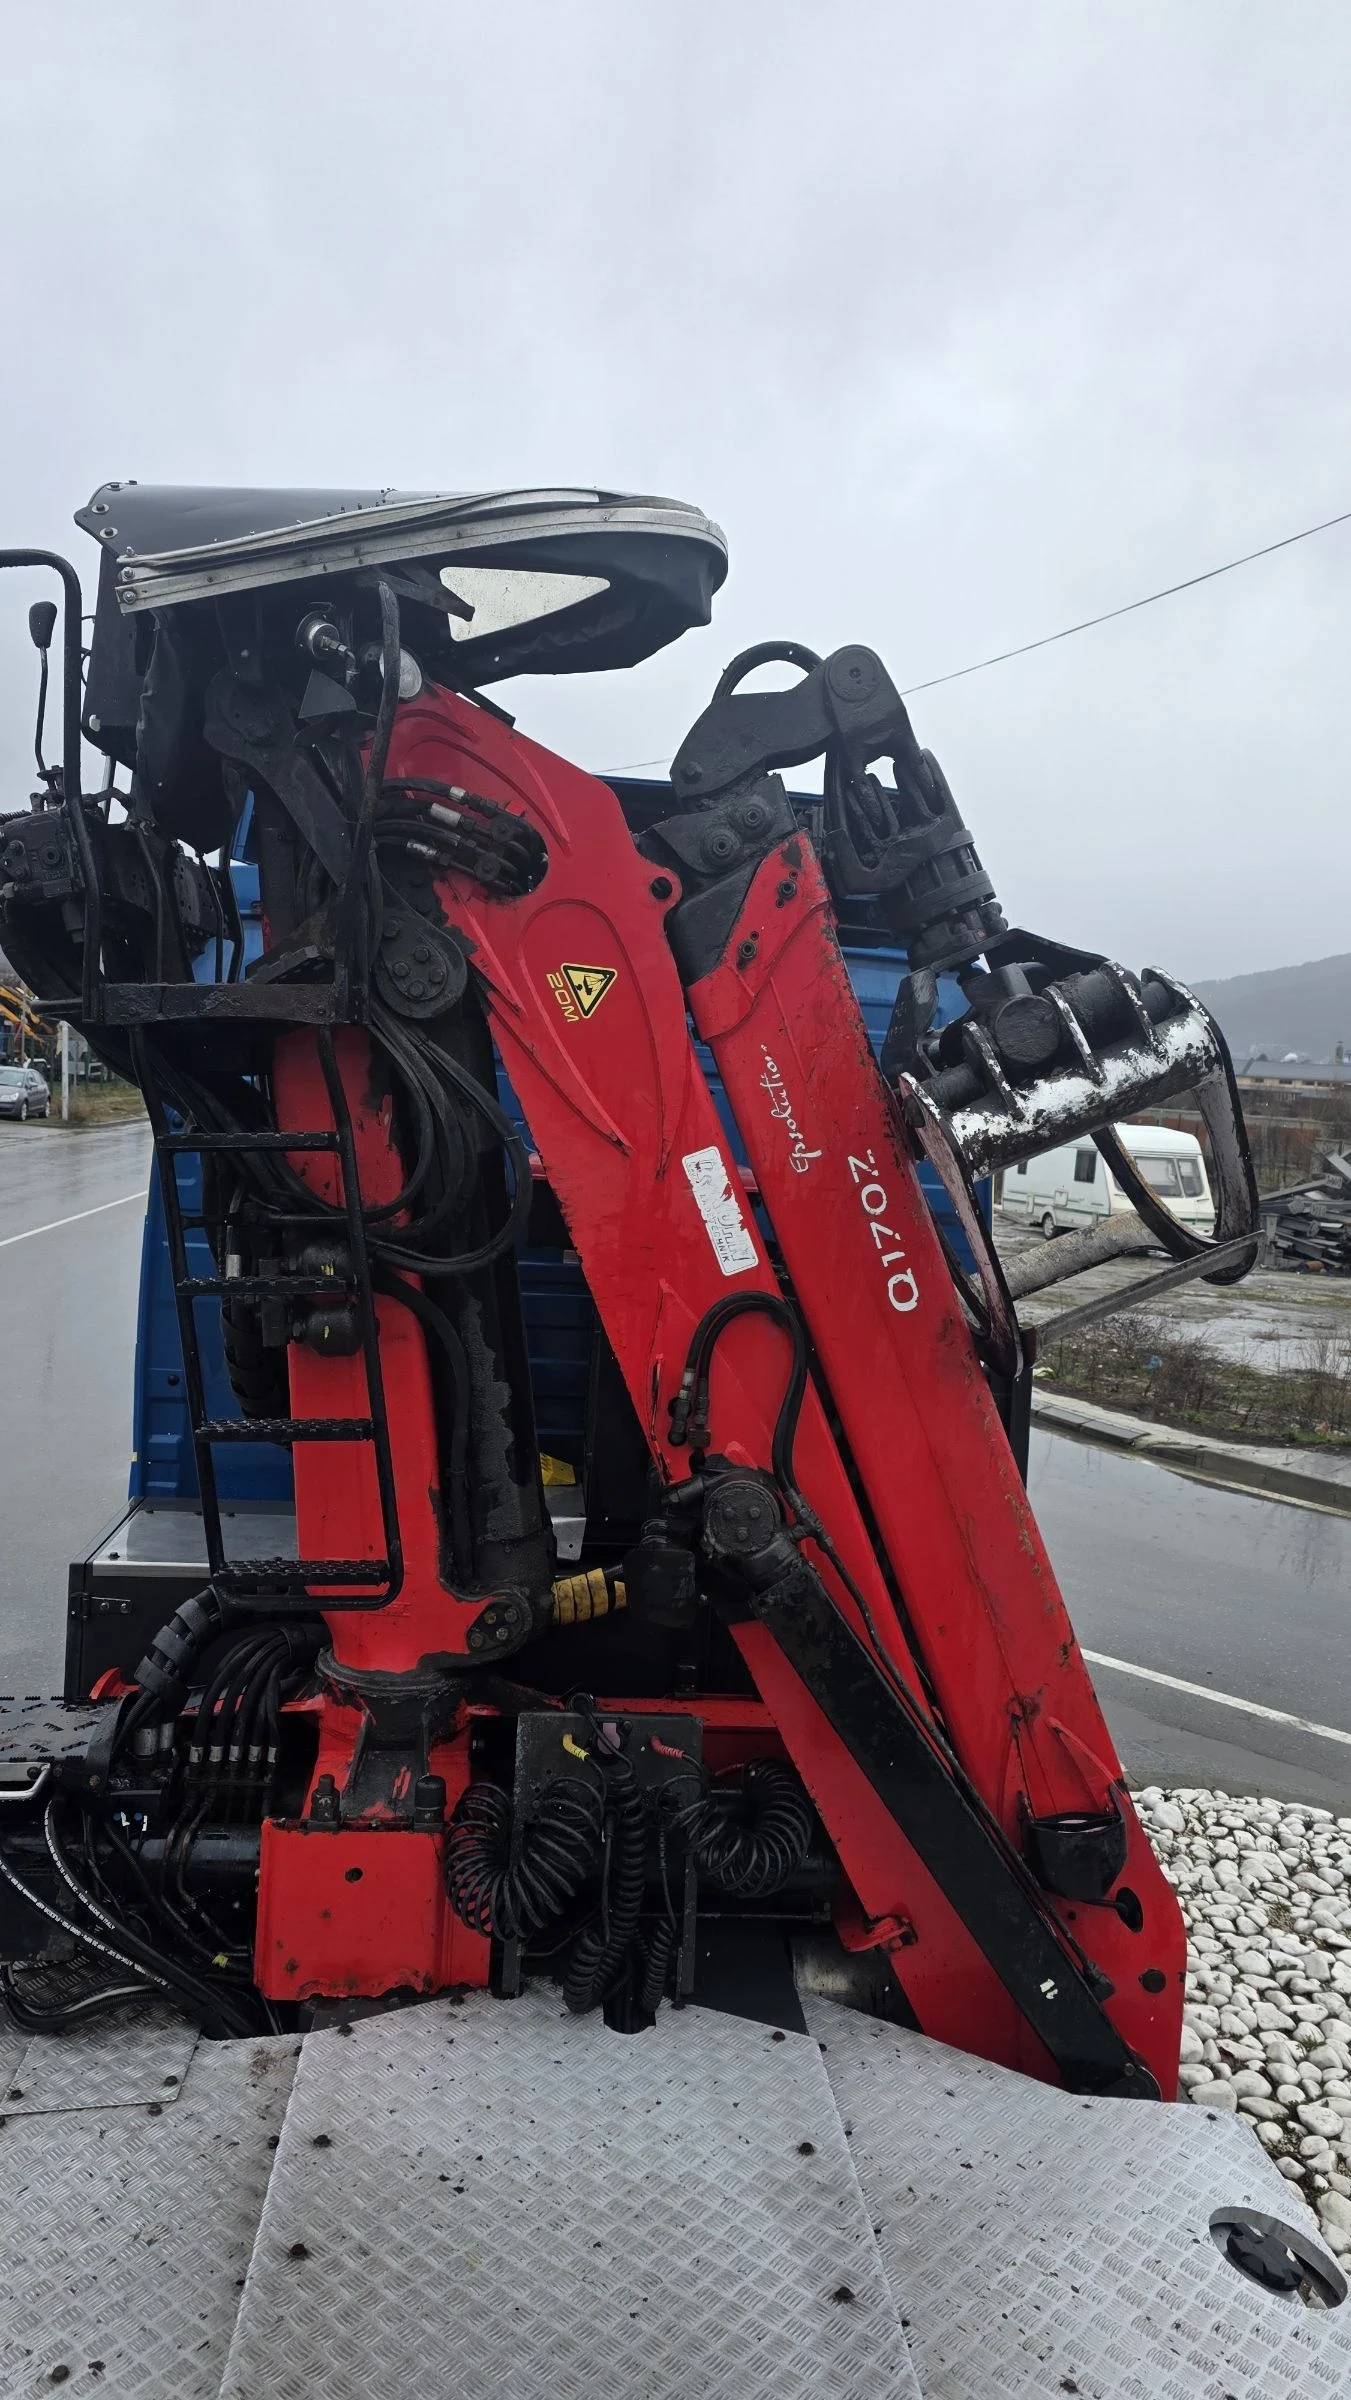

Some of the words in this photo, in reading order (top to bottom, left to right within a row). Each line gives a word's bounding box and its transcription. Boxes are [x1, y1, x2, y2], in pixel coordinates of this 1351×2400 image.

[546, 972, 580, 1023] 20M
[847, 1148, 920, 1313] Q170Z
[103, 1918, 115, 1931] ITALY
